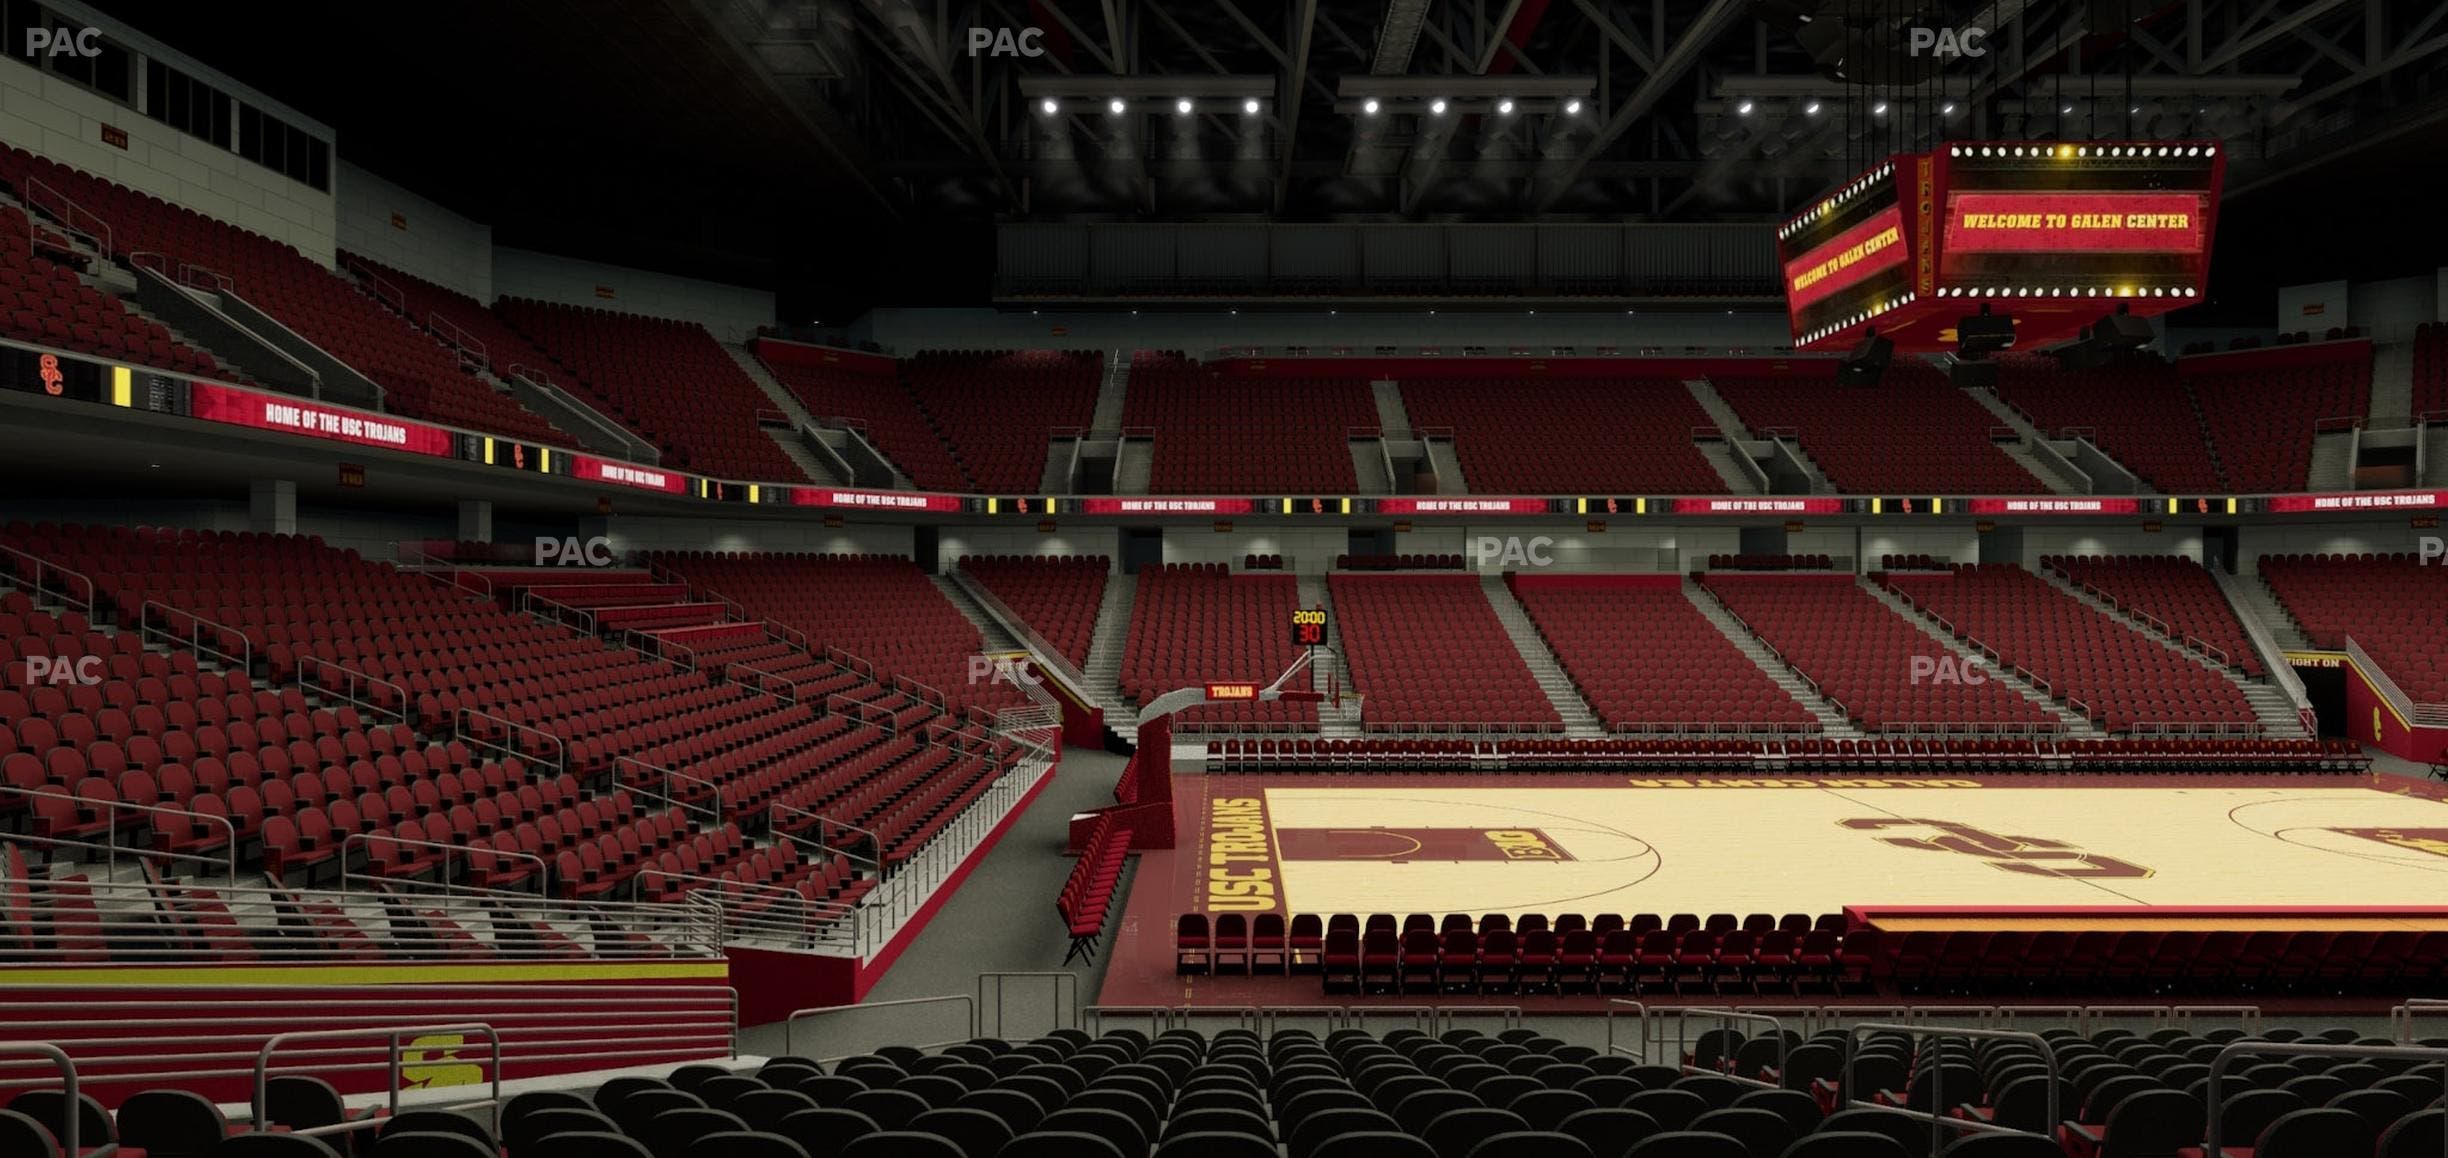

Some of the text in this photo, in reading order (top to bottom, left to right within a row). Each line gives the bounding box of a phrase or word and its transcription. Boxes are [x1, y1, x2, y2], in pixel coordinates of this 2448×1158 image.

[1963, 214, 2189, 229] WELCOME TO GALEN CENTER
[1793, 263, 1828, 291] WELCOME
[1828, 257, 1839, 275] TO
[1864, 226, 1900, 256] CENTER
[266, 403, 406, 444] HOME OF THE USC TROJANS
[832, 493, 927, 507] HOME OF THE USC TROJANS
[1121, 501, 1215, 510] HOME OF THE USC TROJANS
[1416, 501, 1510, 510] HOME OF THE USC TROJANS
[1711, 501, 1805, 510] HOME OF THE USC TROJANS
[2007, 501, 2101, 510] HOME OF THE USC TROJANS
[2315, 495, 2435, 508] HOME OF THE USC TROJANS
[1293, 611, 1326, 624] 20:00
[1300, 625, 1321, 642] 30
[2323, 658, 2340, 668] ON
[1212, 686, 1253, 698] TROJANS
[1208, 798, 1276, 912] USC TROJANS
